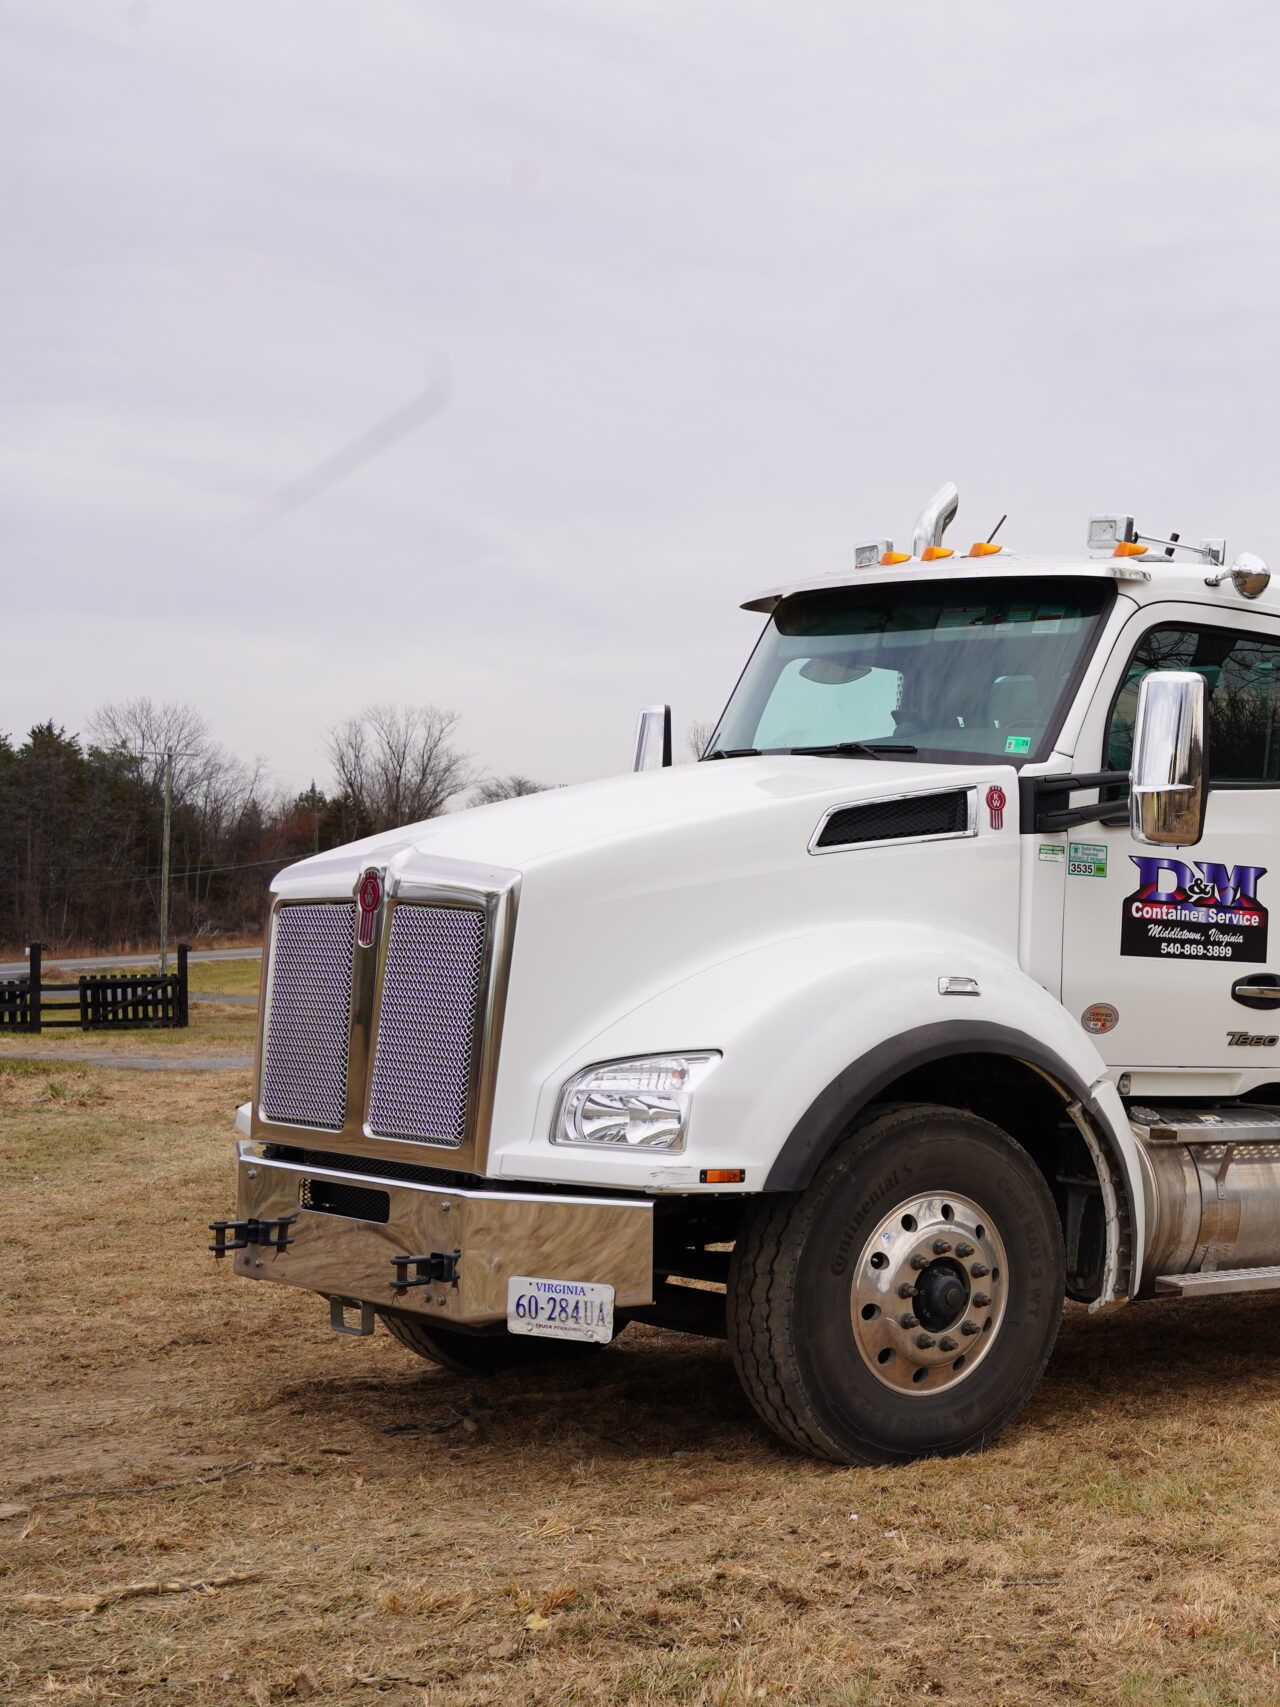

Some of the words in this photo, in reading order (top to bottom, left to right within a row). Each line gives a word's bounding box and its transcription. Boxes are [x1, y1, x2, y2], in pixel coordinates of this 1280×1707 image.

[1070, 863, 1093, 874] 3535
[1128, 855, 1268, 907] D&M
[1131, 901, 1204, 922] Container
[1208, 908, 1260, 927] Service
[1147, 924, 1205, 941] Middletown,
[1209, 928, 1244, 947] Virginia
[1160, 942, 1232, 957] 540-869-3899
[1226, 1031, 1279, 1047] T880
[830, 1169, 900, 1277] Continental
[535, 1282, 587, 1297] VIRGINIA
[515, 1293, 607, 1328] 60-284UA
